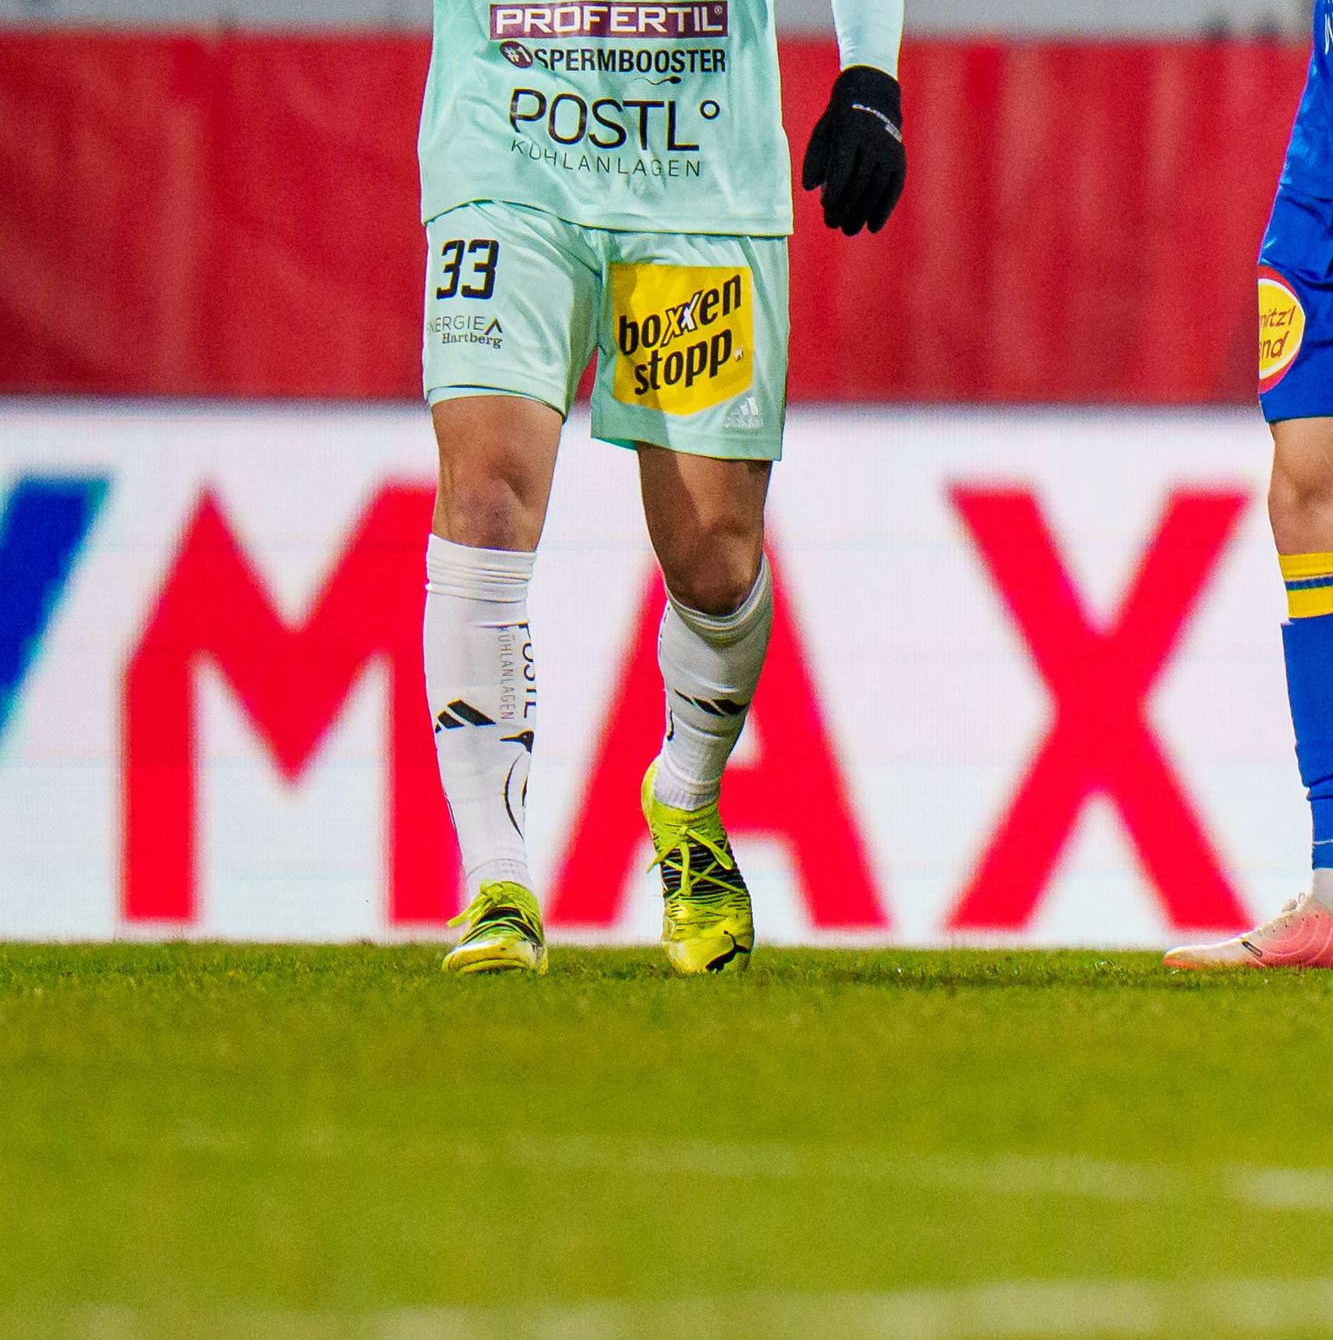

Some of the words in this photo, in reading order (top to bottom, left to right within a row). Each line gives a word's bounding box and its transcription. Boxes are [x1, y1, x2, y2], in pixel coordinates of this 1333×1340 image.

[534, 47, 726, 73] SPERMBOOSTER
[511, 139, 701, 178] KÜHLANLAGEN
[436, 239, 500, 301] 33
[619, 274, 743, 357] boxxen
[441, 331, 503, 350] Hartberg
